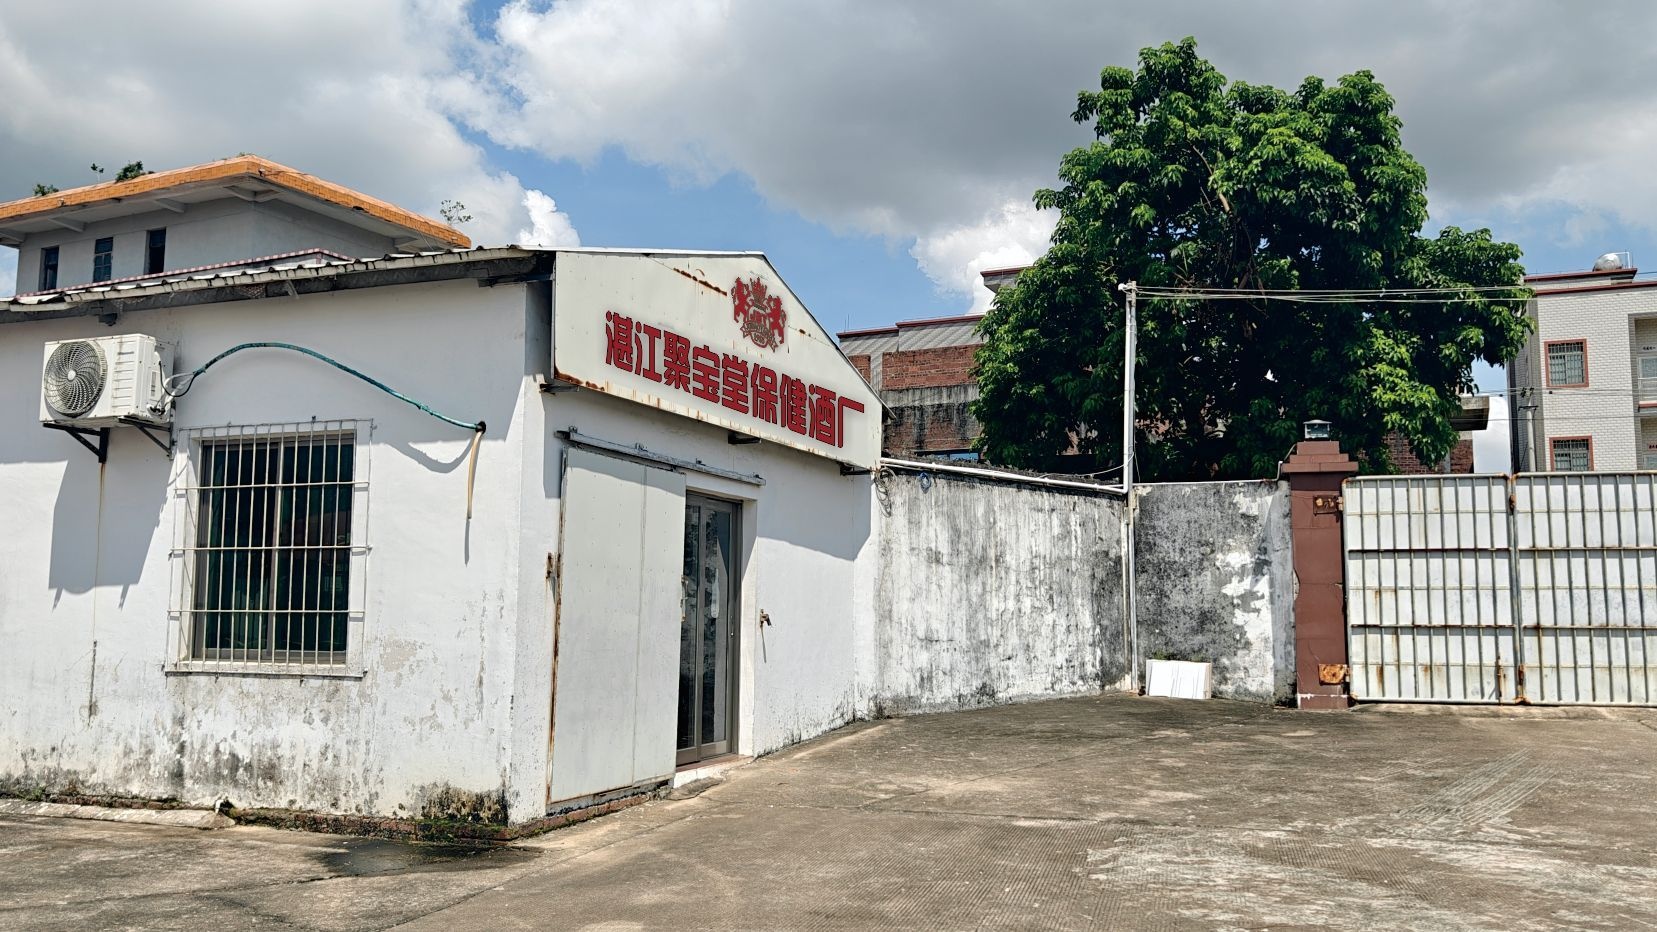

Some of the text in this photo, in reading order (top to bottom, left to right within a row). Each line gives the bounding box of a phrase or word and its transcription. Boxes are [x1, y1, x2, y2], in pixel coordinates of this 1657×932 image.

[605, 310, 864, 448] 湛江聚宝堂保健酒厂
